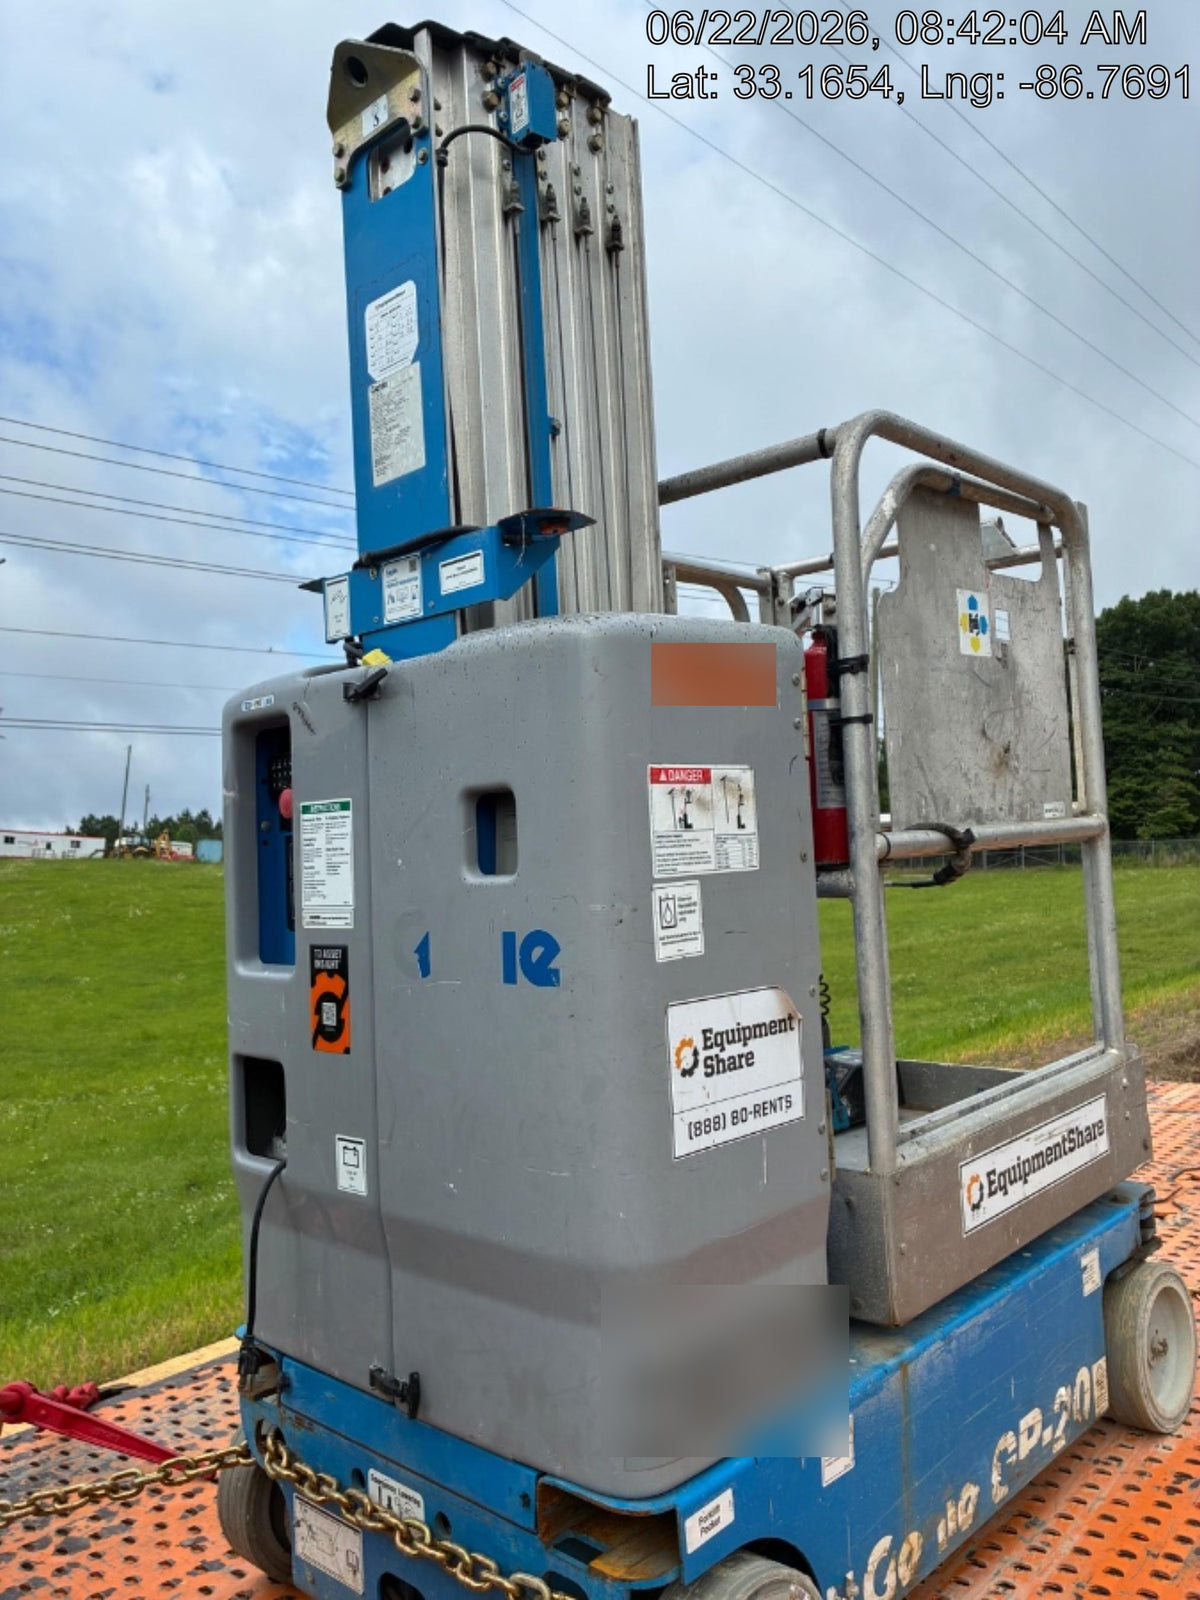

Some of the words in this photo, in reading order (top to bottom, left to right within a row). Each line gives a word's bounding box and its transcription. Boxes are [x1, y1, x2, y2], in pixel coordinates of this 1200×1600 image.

[667, 769, 703, 782] DANGER
[701, 1012, 796, 1052] Equipment
[703, 1050, 756, 1078] Share
[687, 1112, 726, 1140] (888)
[731, 1094, 793, 1126] 80-RENTS
[985, 1118, 1105, 1199] EquipmentShare
